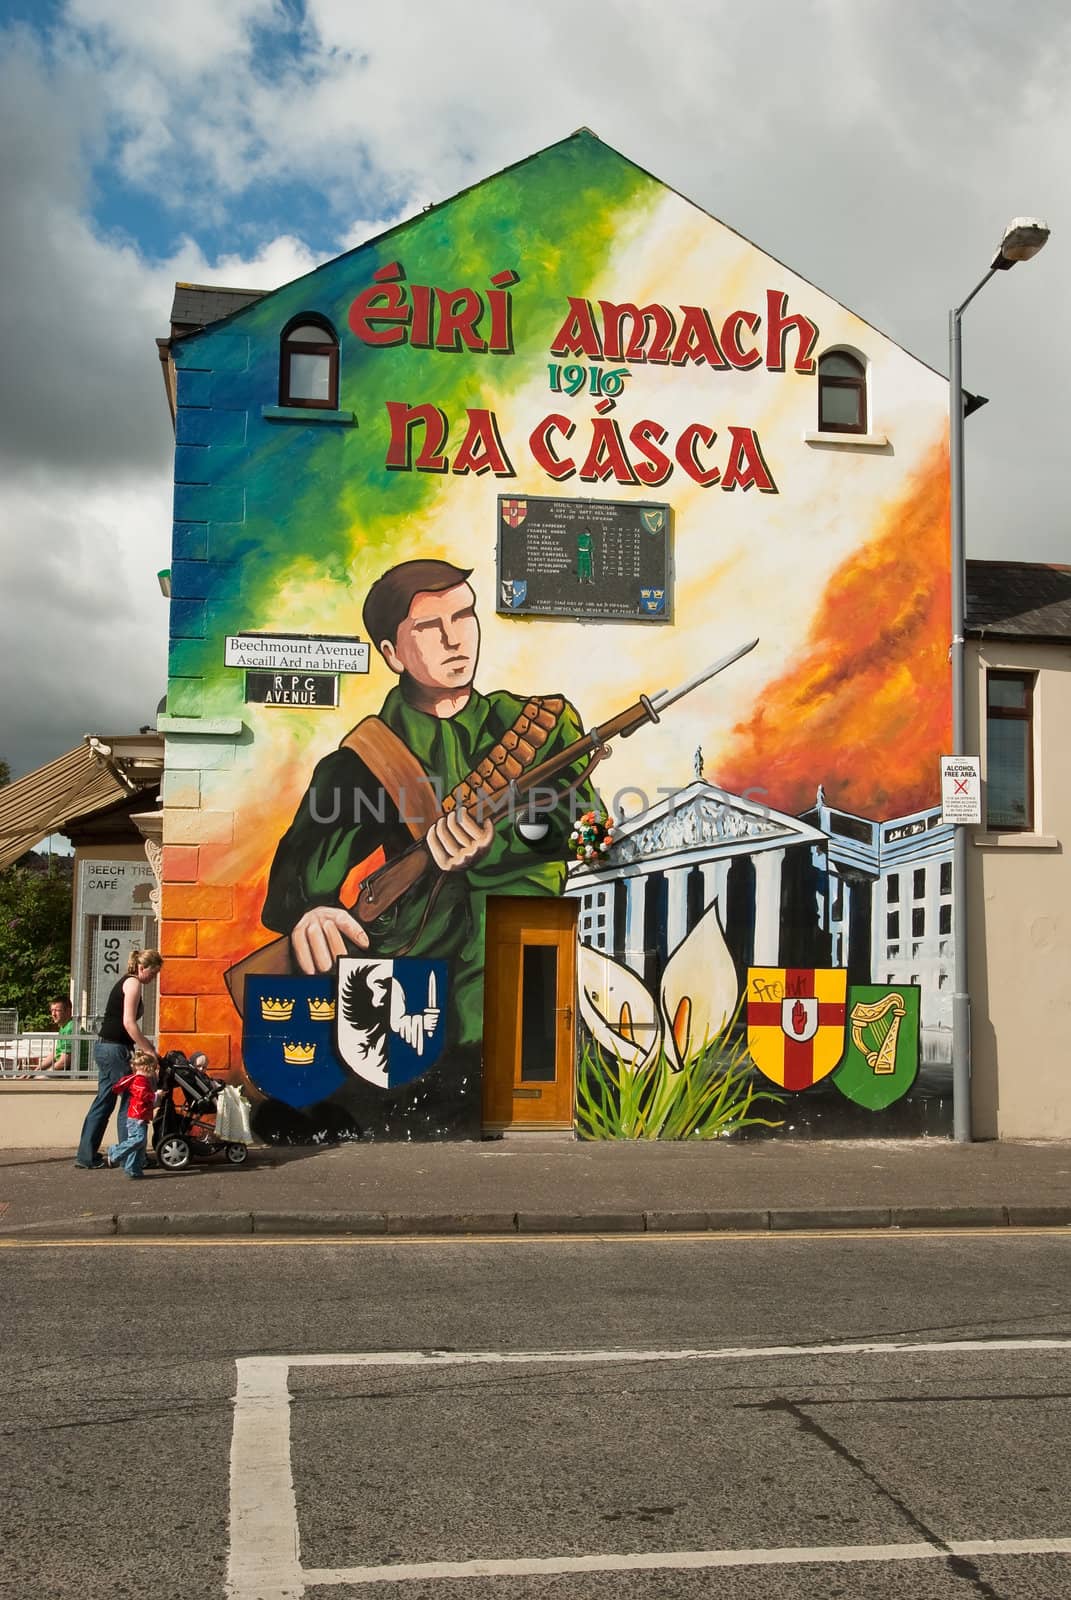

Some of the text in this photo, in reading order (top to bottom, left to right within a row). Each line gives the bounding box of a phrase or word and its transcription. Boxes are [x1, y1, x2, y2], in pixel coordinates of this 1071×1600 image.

[548, 364, 632, 397] 1916
[385, 398, 779, 494] NA CÁSCA
[231, 639, 365, 656] Beechmount Avenue
[236, 655, 358, 671] Ascaill Ard na bhFeá
[265, 691, 317, 704] AVENUE
[88, 866, 125, 875] BEECH
[88, 878, 118, 889] CAFÉ
[104, 938, 120, 974] 265
